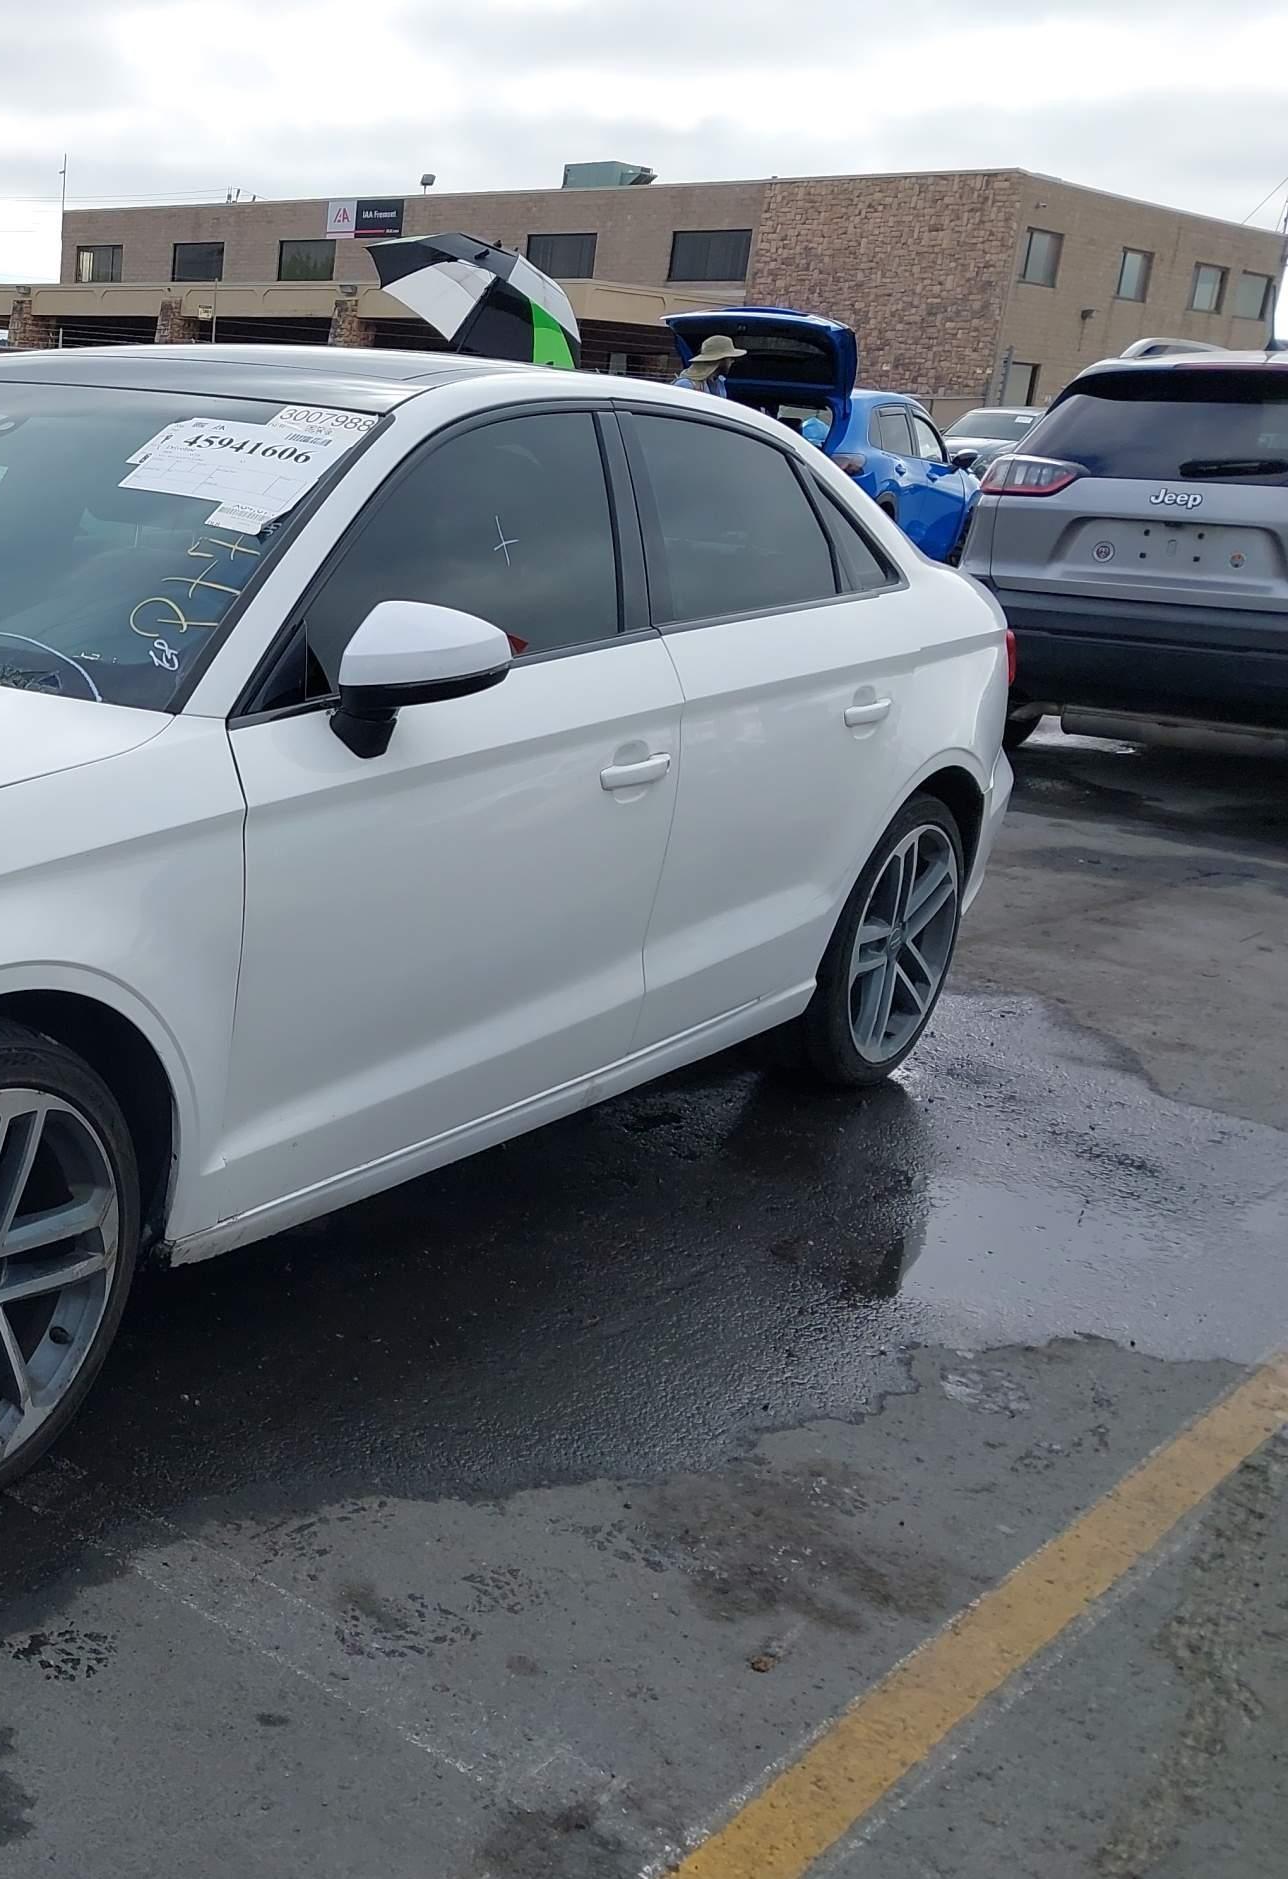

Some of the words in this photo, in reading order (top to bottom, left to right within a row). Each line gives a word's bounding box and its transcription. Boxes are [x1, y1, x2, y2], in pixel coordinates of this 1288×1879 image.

[280, 408, 375, 432] 3007988
[183, 434, 318, 464] 45941606
[1149, 488, 1203, 510] Jeep
